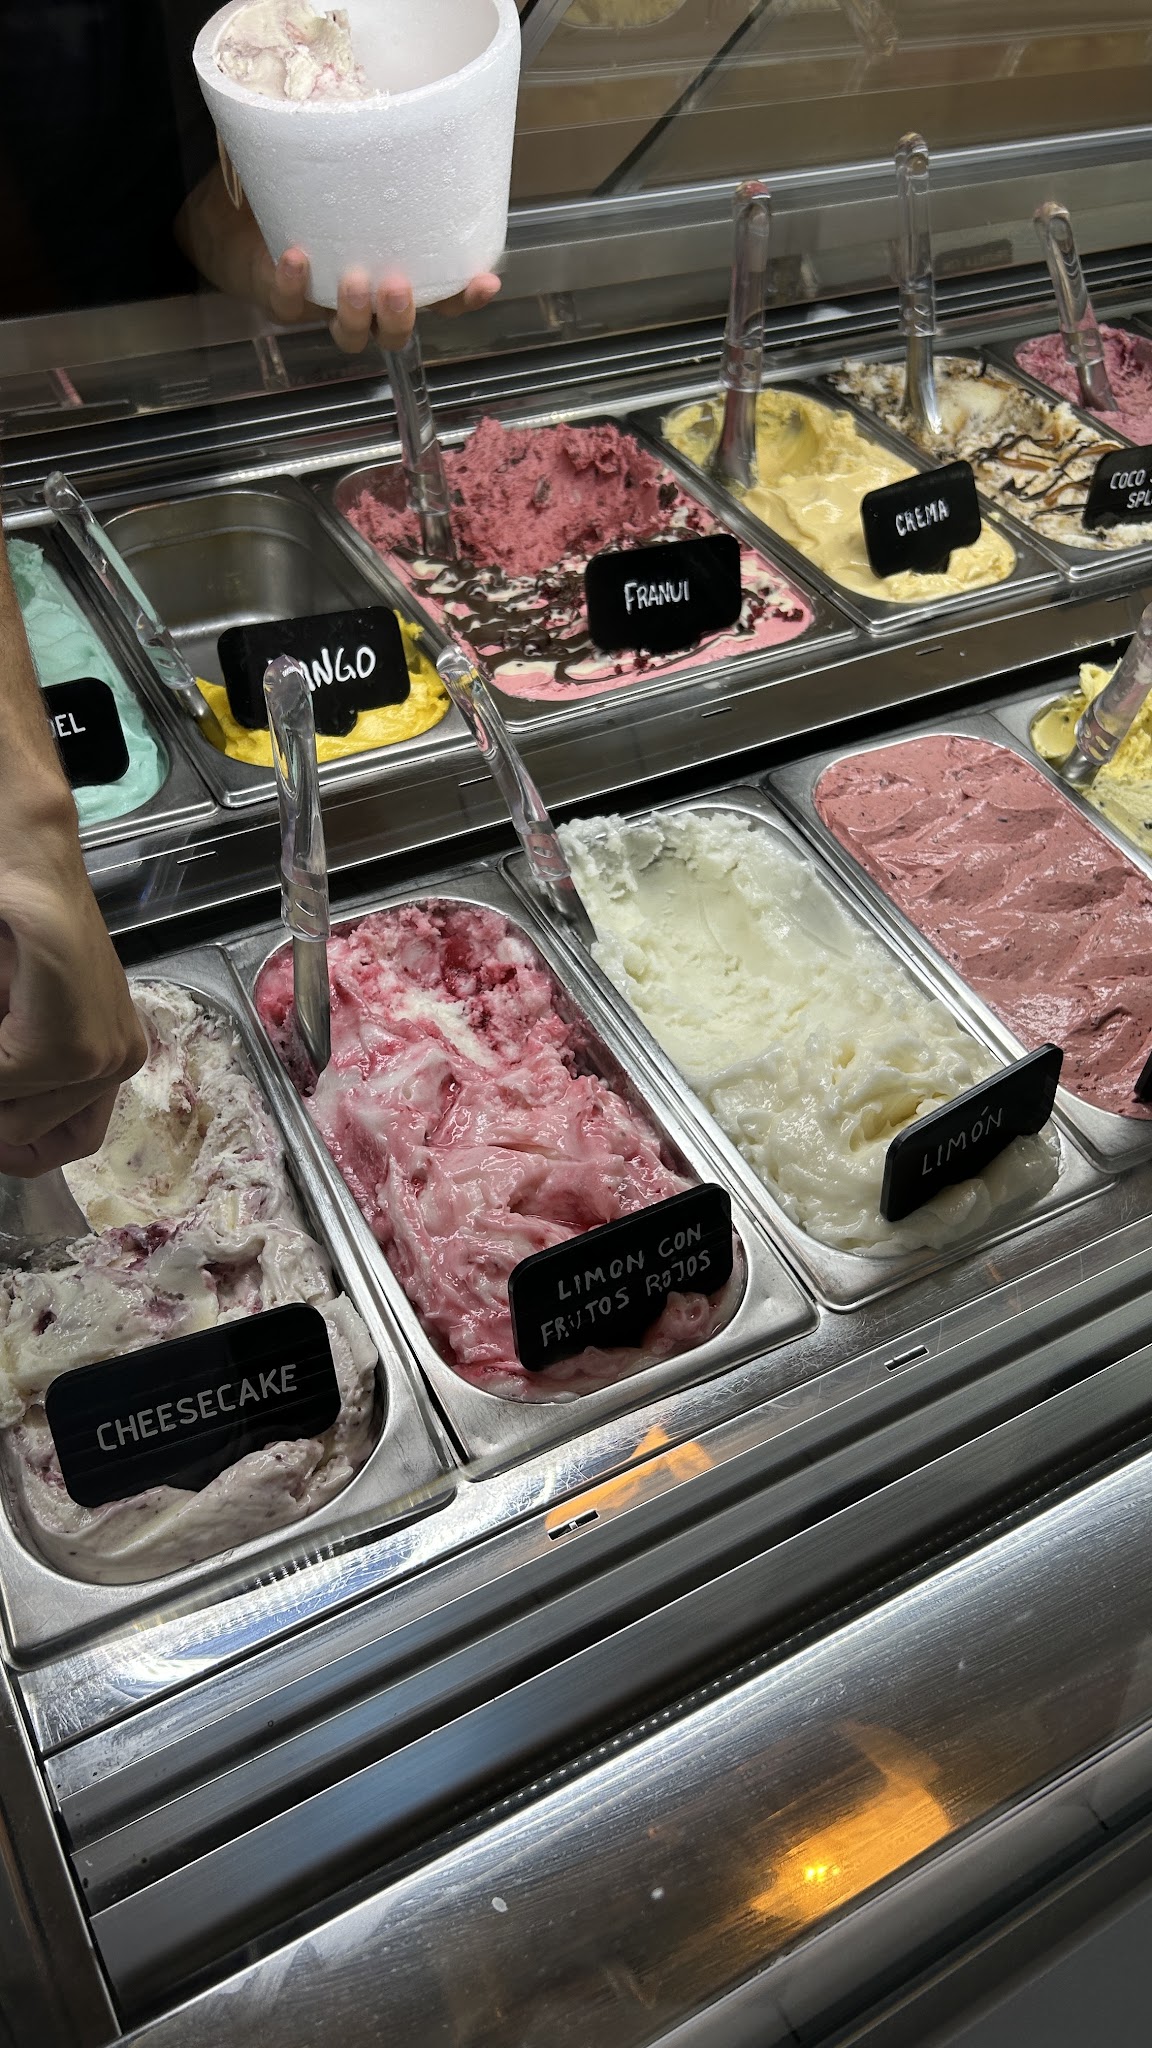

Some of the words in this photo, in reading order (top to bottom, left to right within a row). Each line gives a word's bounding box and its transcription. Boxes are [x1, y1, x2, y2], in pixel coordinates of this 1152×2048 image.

[1110, 469, 1146, 490] COCO
[895, 499, 950, 537] CREMA
[1126, 489, 1152, 509] SPL
[624, 579, 690, 615] FRANUI
[48, 712, 87, 738] EL
[921, 1105, 1003, 1176] LIMÓN
[558, 1250, 645, 1300] LIMON
[658, 1223, 701, 1258] CON
[540, 1286, 630, 1347] FRUTOS
[645, 1250, 711, 1296] ROJOS
[96, 1363, 298, 1451] CHEESECAKE
